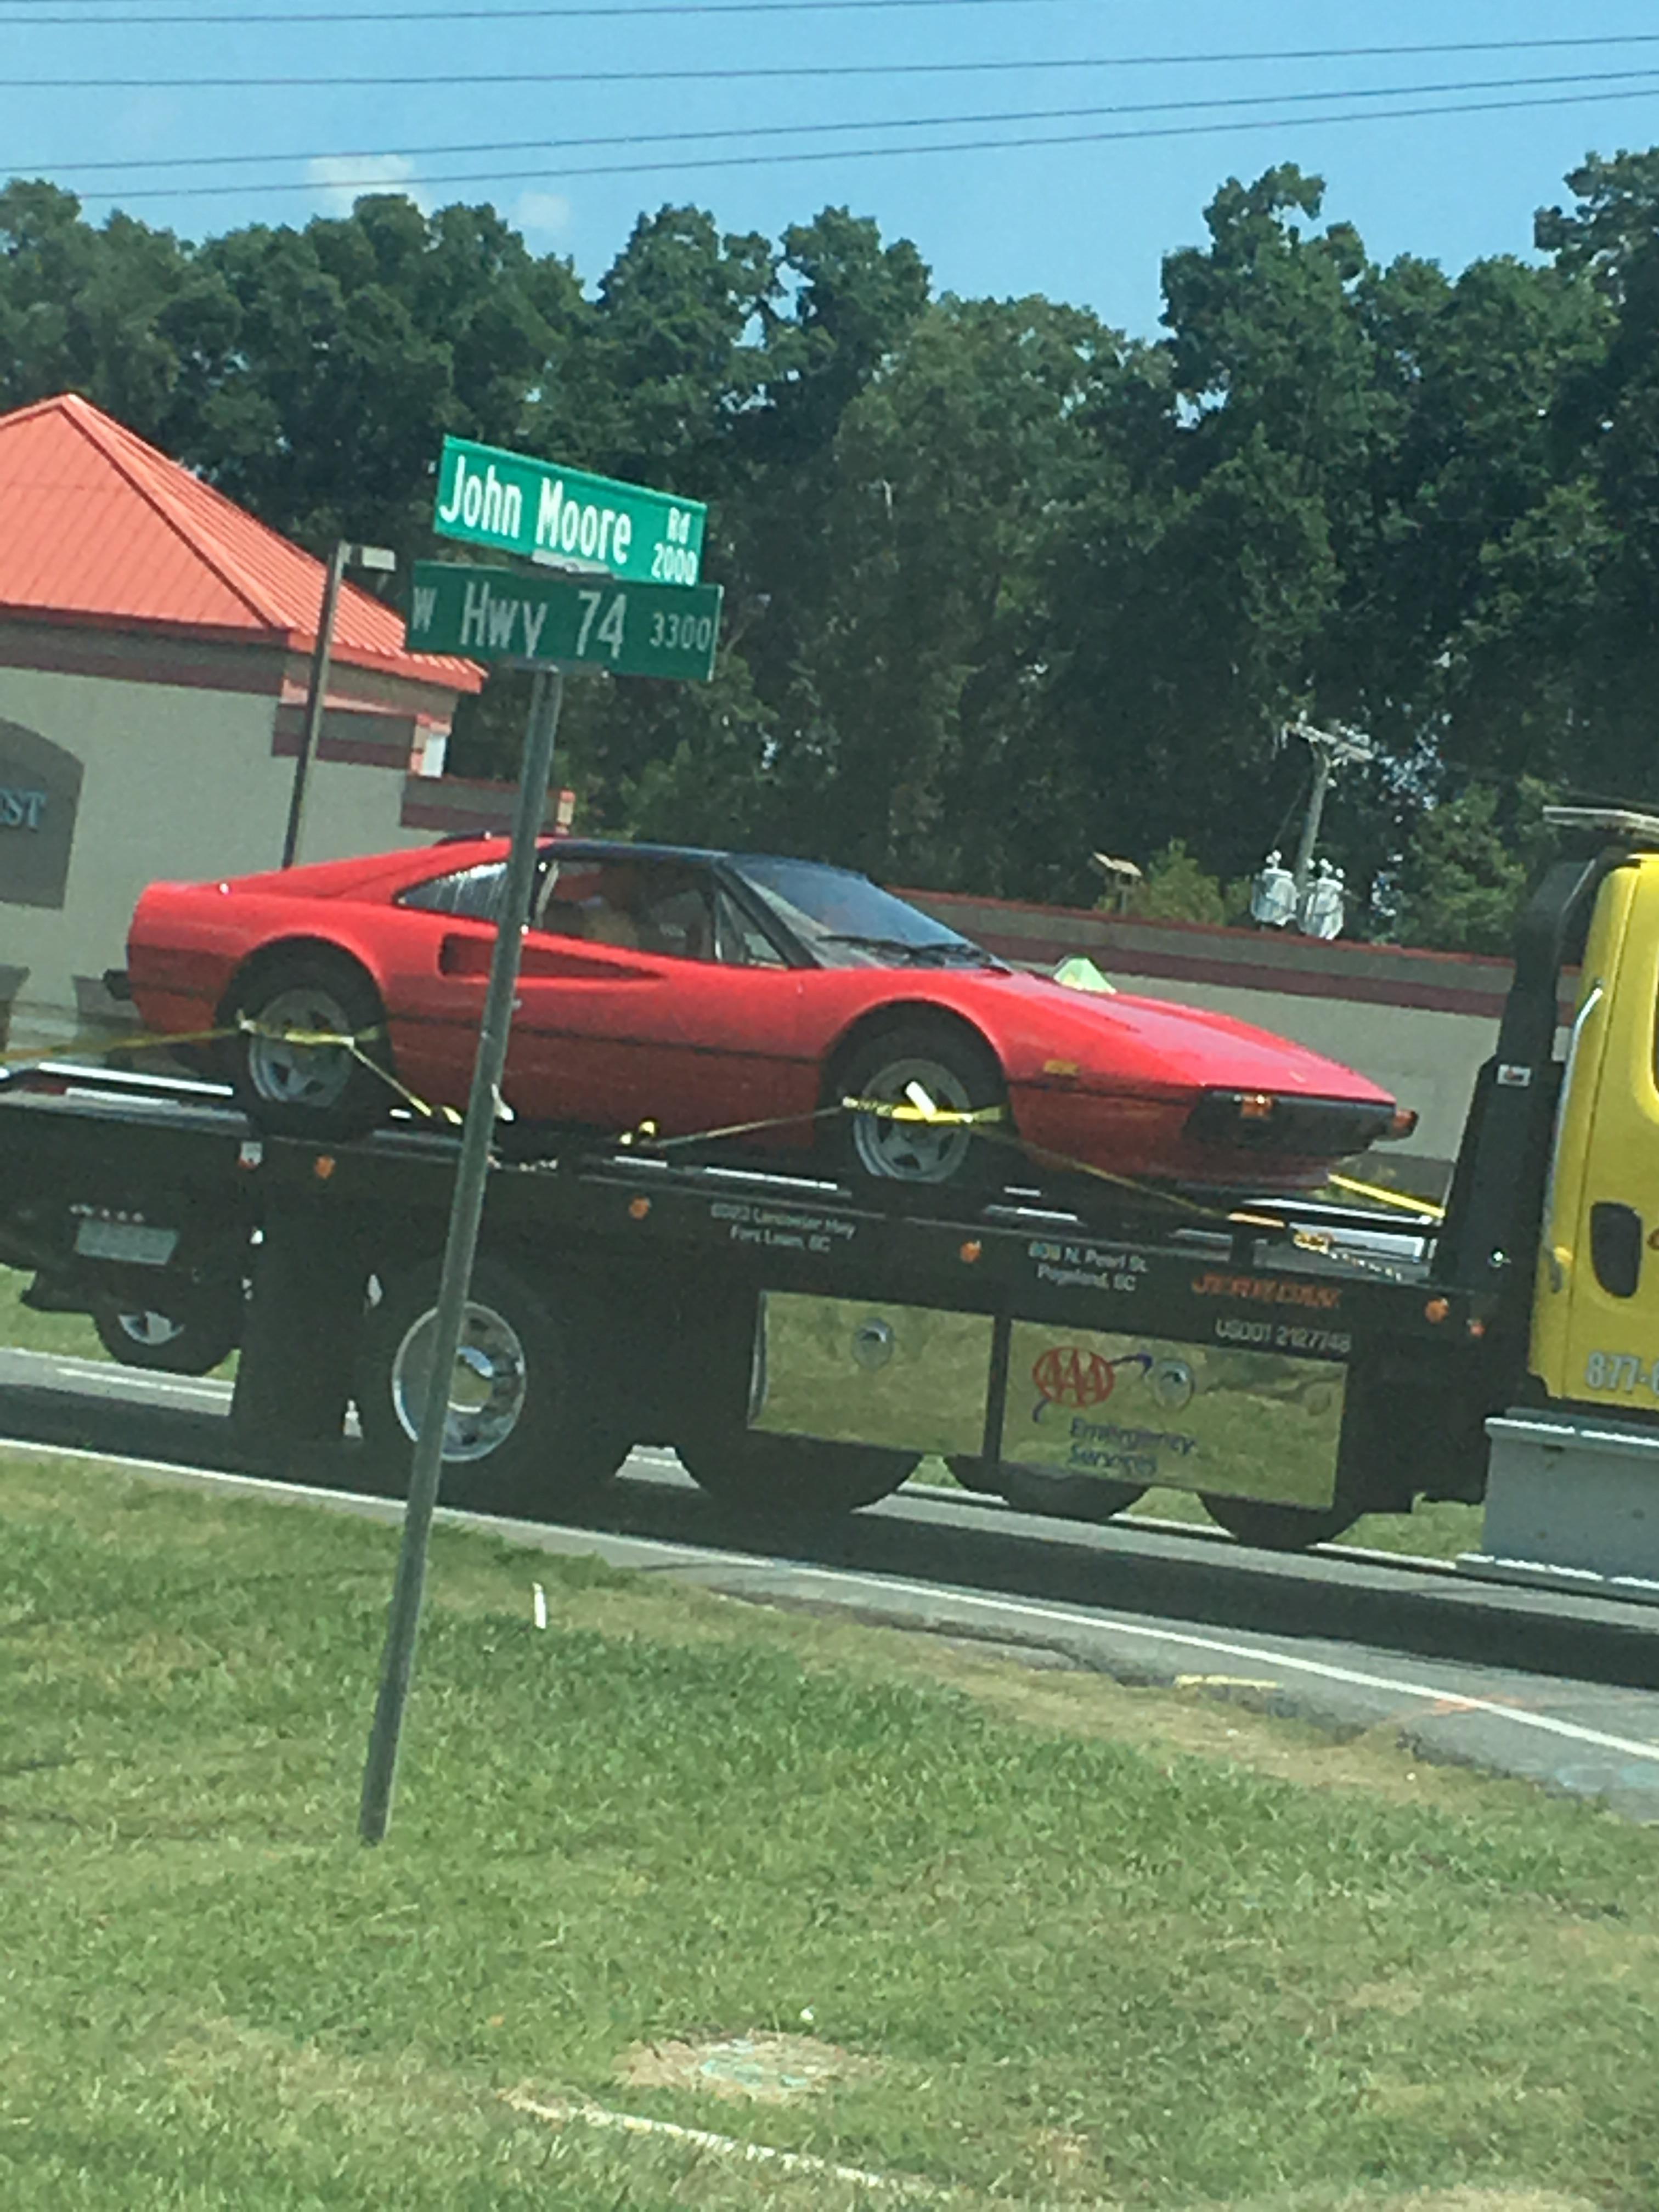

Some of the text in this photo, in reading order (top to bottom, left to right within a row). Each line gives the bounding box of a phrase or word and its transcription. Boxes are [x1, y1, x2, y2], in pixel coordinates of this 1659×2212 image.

[439, 455, 691, 565] John Moore Rd
[651, 543, 698, 586] 2000
[411, 582, 712, 659] W Hwy 74 3300
[1032, 1346, 1115, 1408] AAA
[1070, 1415, 1197, 1455] Emergency
